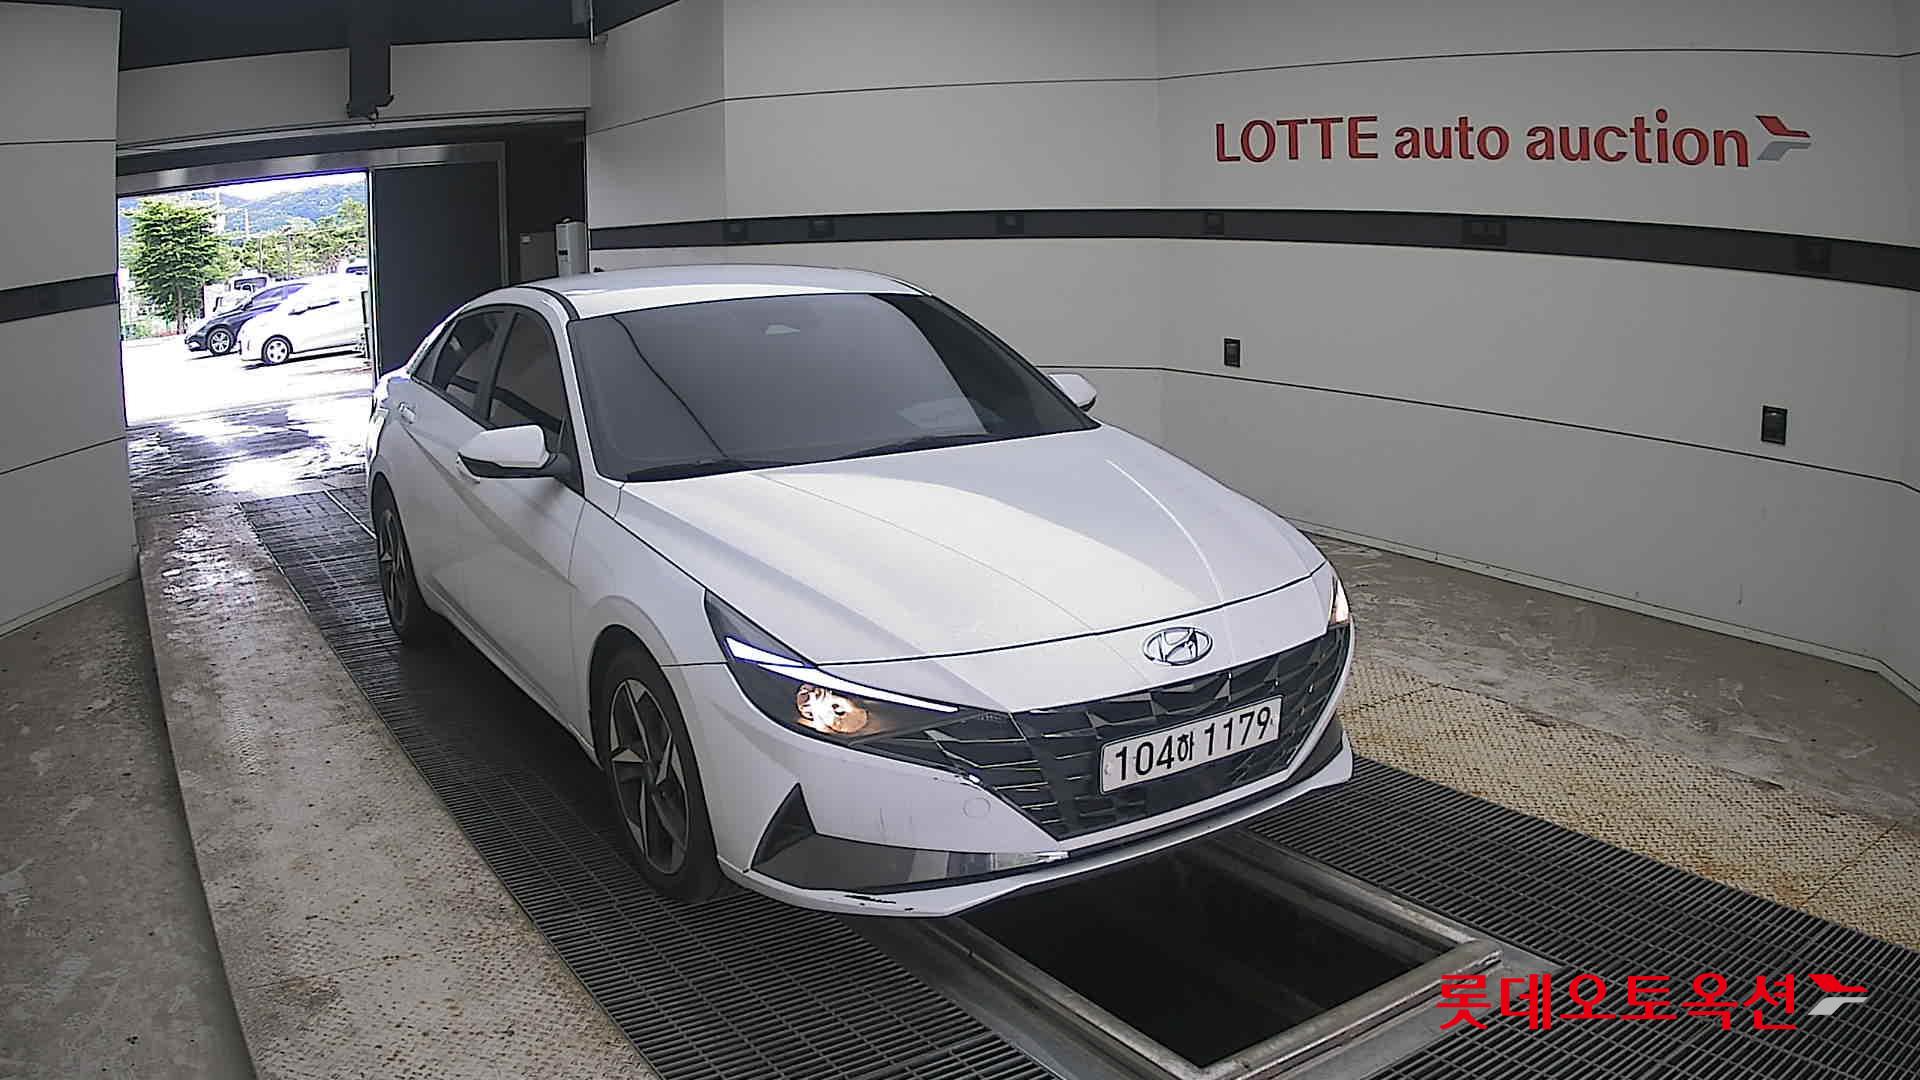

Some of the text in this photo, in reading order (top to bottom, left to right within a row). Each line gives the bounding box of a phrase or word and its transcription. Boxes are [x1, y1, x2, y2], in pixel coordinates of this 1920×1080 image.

[1215, 109, 1749, 168] LOTTE auto auction
[1115, 706, 1271, 781] 104하 1179
